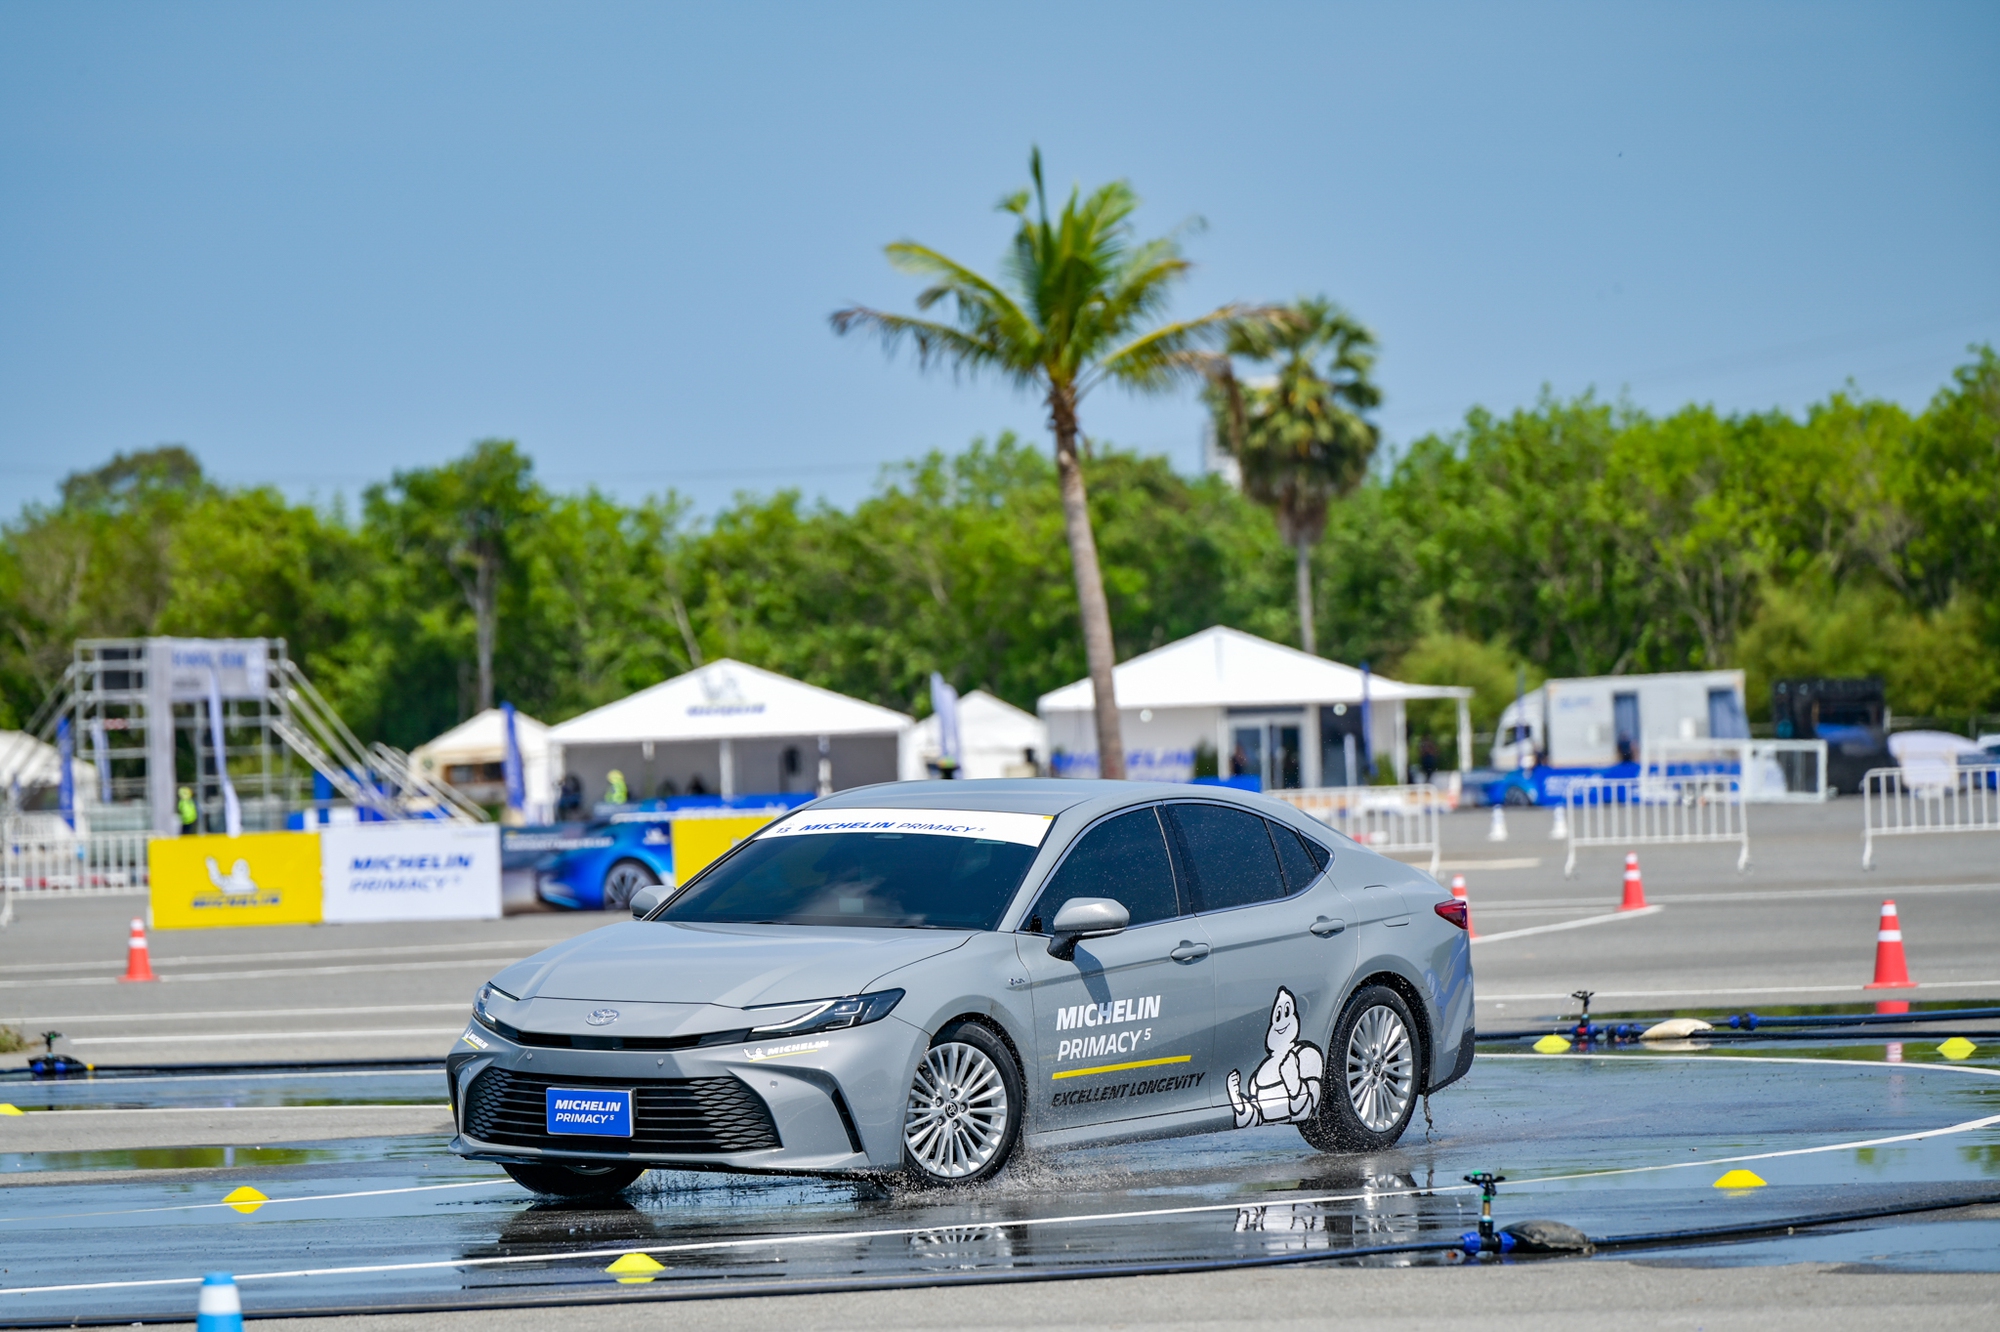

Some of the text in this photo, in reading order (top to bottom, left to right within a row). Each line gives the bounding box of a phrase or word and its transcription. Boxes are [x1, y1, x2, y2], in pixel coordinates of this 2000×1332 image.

[798, 821, 896, 831] MICHELIN
[896, 822, 976, 833] PRIMACY
[1055, 994, 1162, 1031] MICHELIN
[766, 1040, 829, 1056] MICHELIN
[1057, 1029, 1142, 1062] PRIMACY
[1051, 1071, 1206, 1107] EXCELLENT LONGEVITY
[554, 1099, 621, 1112] MICHELIN
[555, 1112, 608, 1124] PRIMACY
